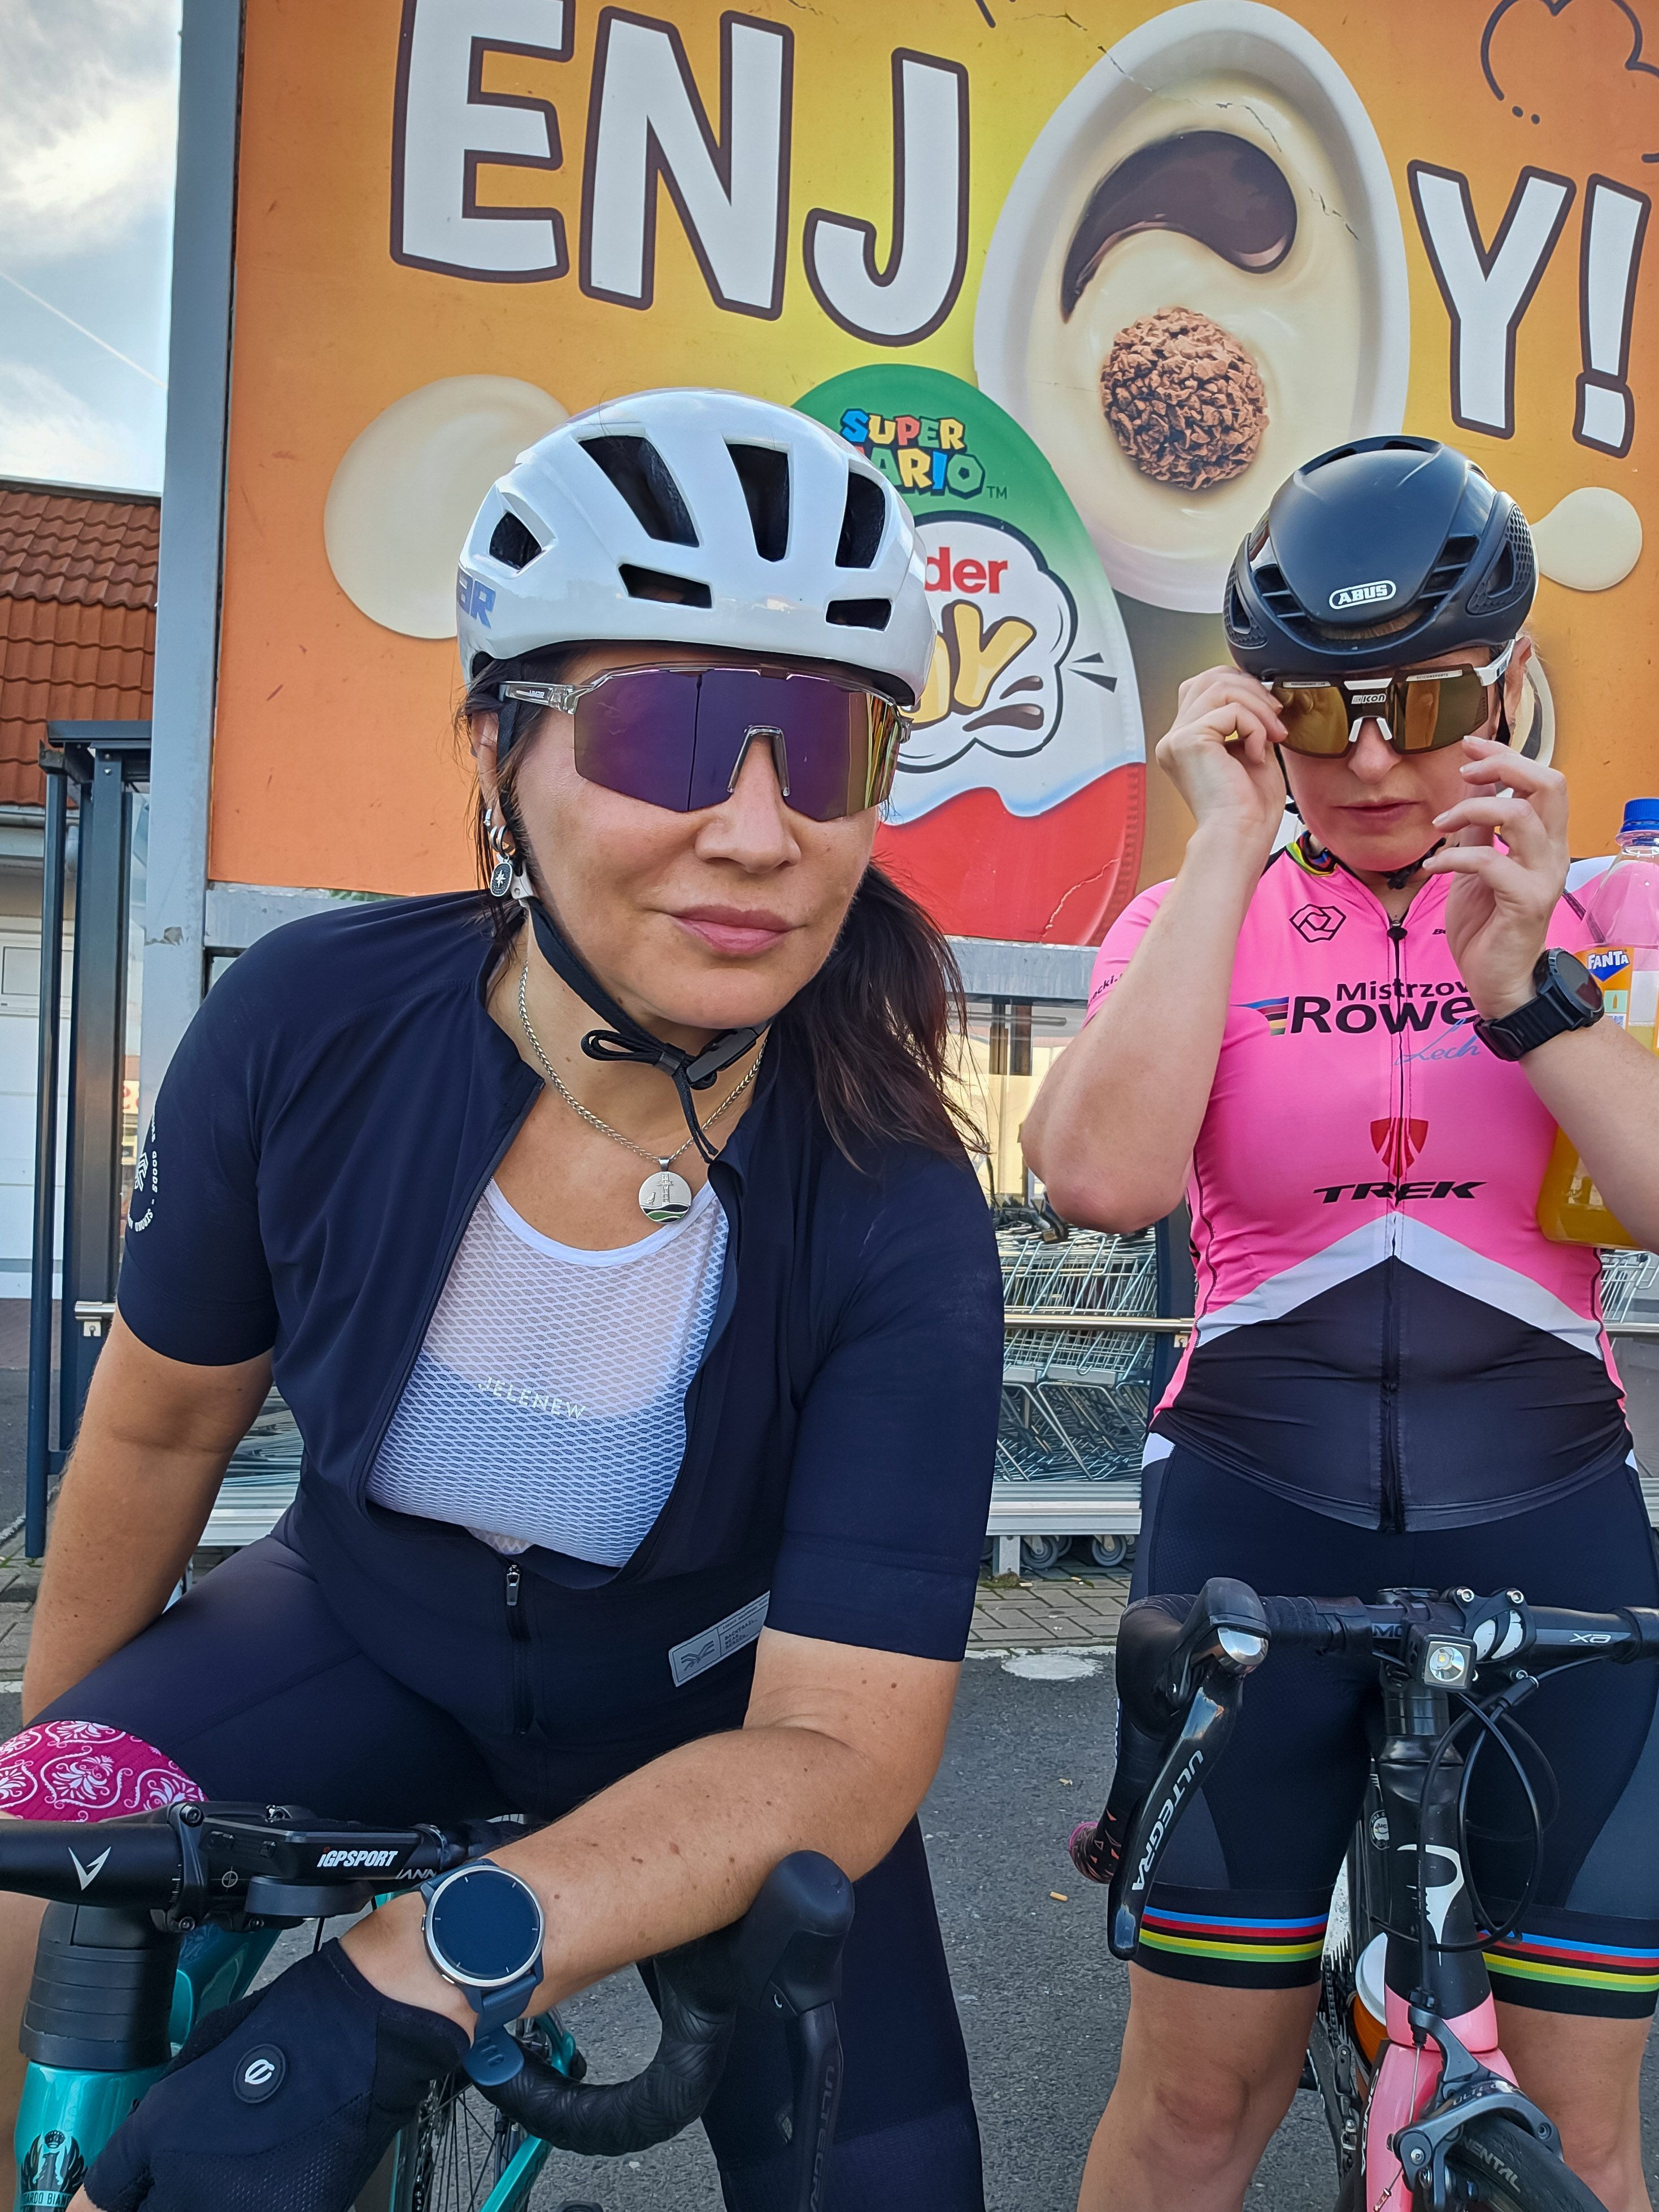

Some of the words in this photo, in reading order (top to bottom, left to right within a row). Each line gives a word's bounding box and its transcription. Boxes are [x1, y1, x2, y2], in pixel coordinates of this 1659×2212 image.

[841, 408, 965, 452] SUPER
[925, 547, 1008, 594] der
[1338, 584, 1388, 606] ABUS
[1588, 951, 1629, 970] FANTA
[1291, 996, 1481, 1035] Rowe
[1313, 1181, 1487, 1204] TREK
[1131, 1750, 1204, 1890] ULTEGRA
